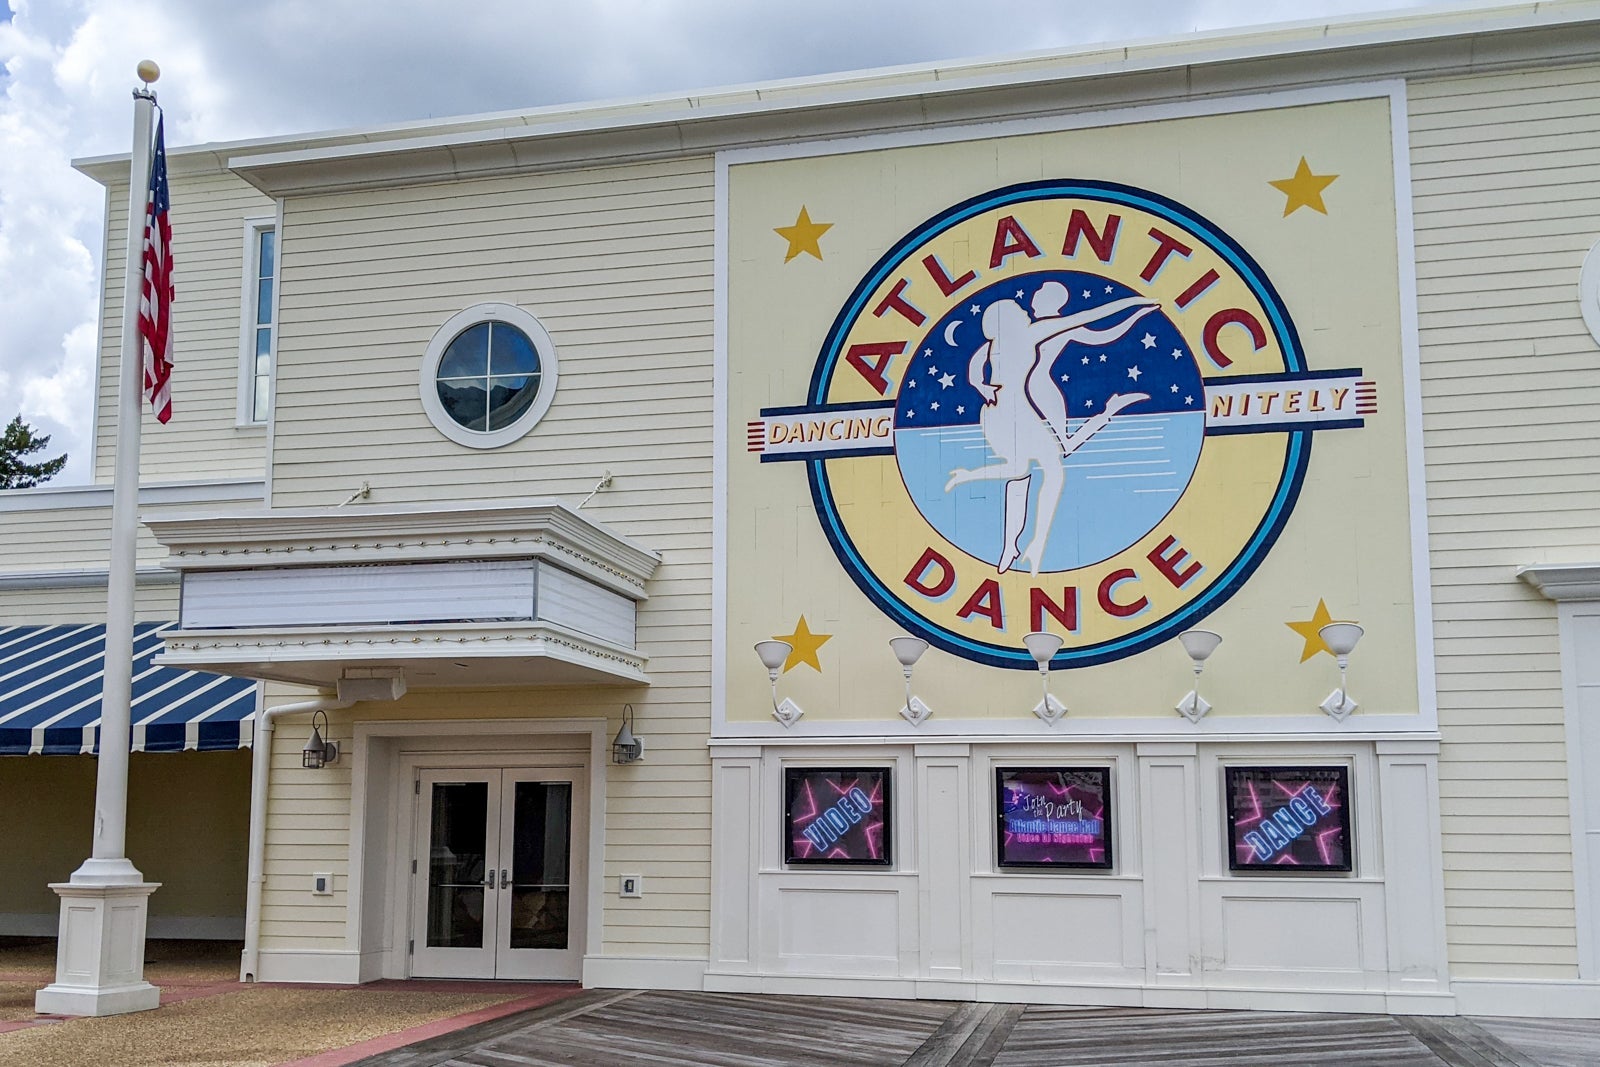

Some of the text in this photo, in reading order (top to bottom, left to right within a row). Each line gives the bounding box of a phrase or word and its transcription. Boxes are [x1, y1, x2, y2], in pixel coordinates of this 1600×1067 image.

[845, 208, 1268, 396] ATLANTIC
[769, 387, 1350, 445] DANCING NITELY
[902, 534, 1203, 633] DANCE
[802, 786, 873, 852] VIDEO
[1009, 819, 1046, 833] Atlantic
[1048, 819, 1079, 834] Dance
[1022, 794, 1046, 811] Join
[1045, 799, 1084, 822] Party
[1243, 785, 1332, 861] DANCE
